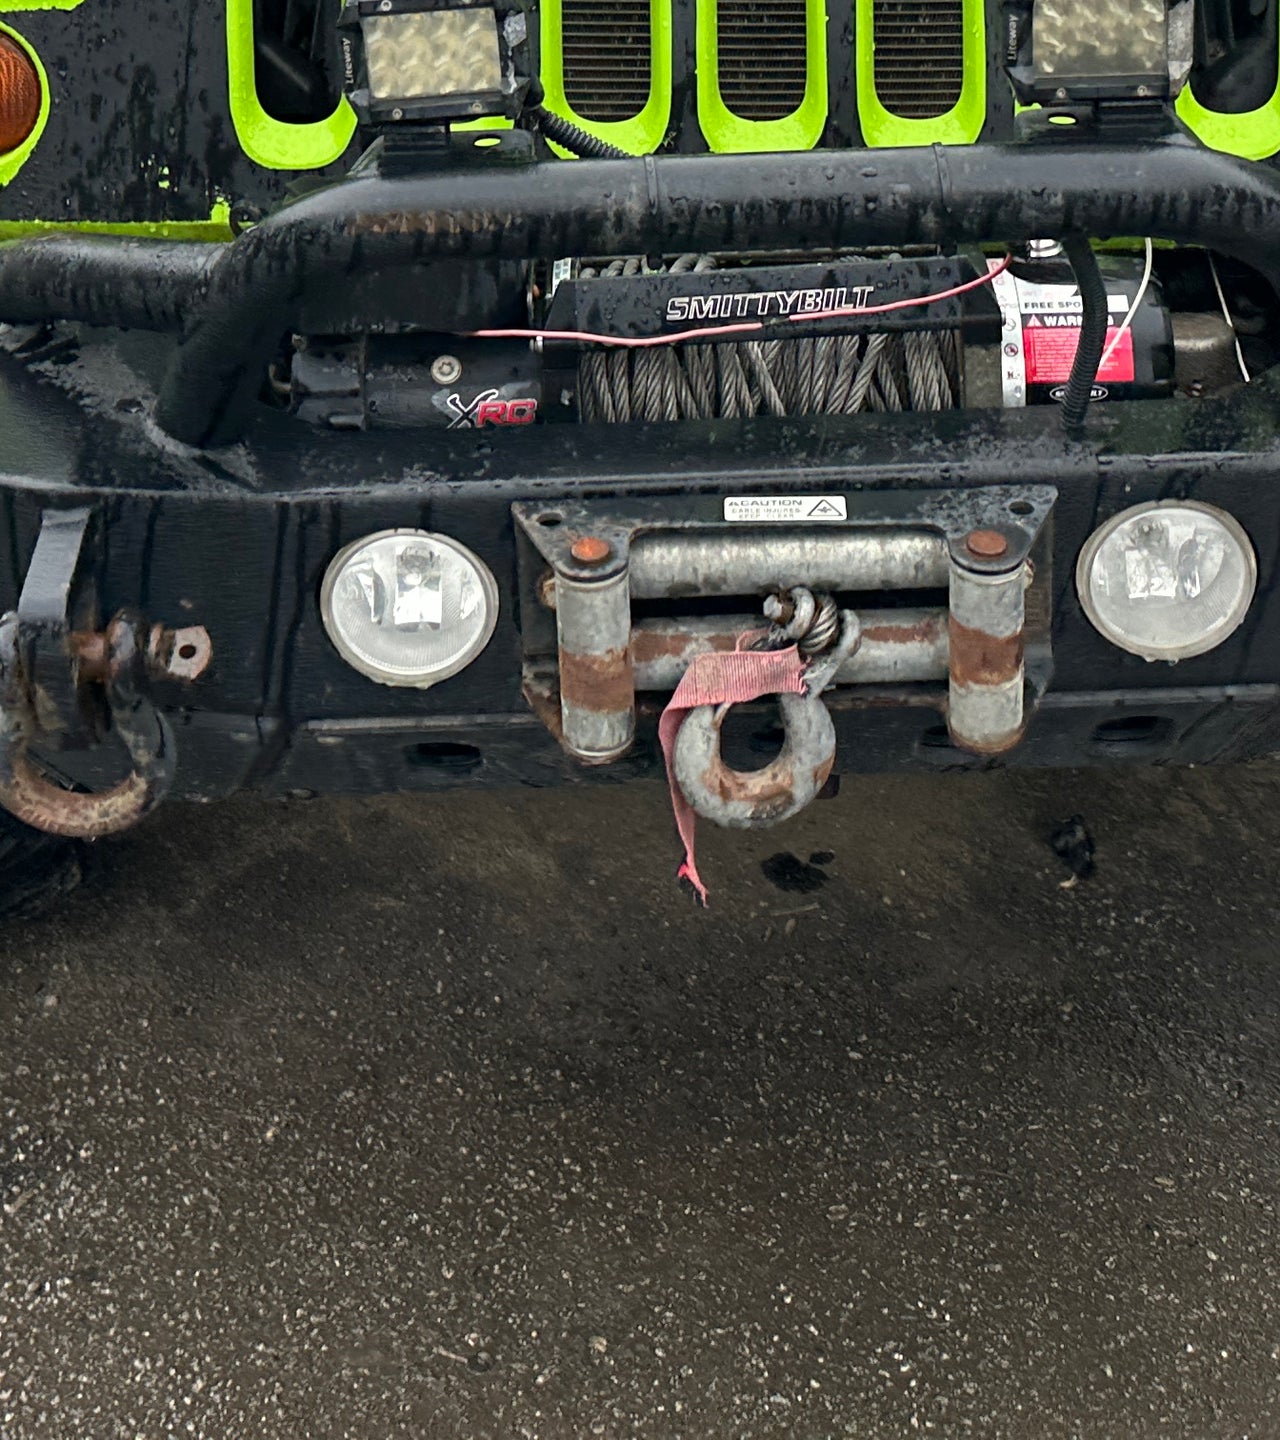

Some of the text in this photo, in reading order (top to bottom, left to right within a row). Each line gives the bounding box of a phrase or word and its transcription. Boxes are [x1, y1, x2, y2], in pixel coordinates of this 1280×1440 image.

[1007, 14, 1019, 60] Liteway
[342, 37, 355, 84] Liteway
[665, 285, 875, 321] SMITTYBILT
[1023, 301, 1054, 310] FREE
[446, 388, 538, 429] XRC
[740, 499, 803, 507] CAUTION
